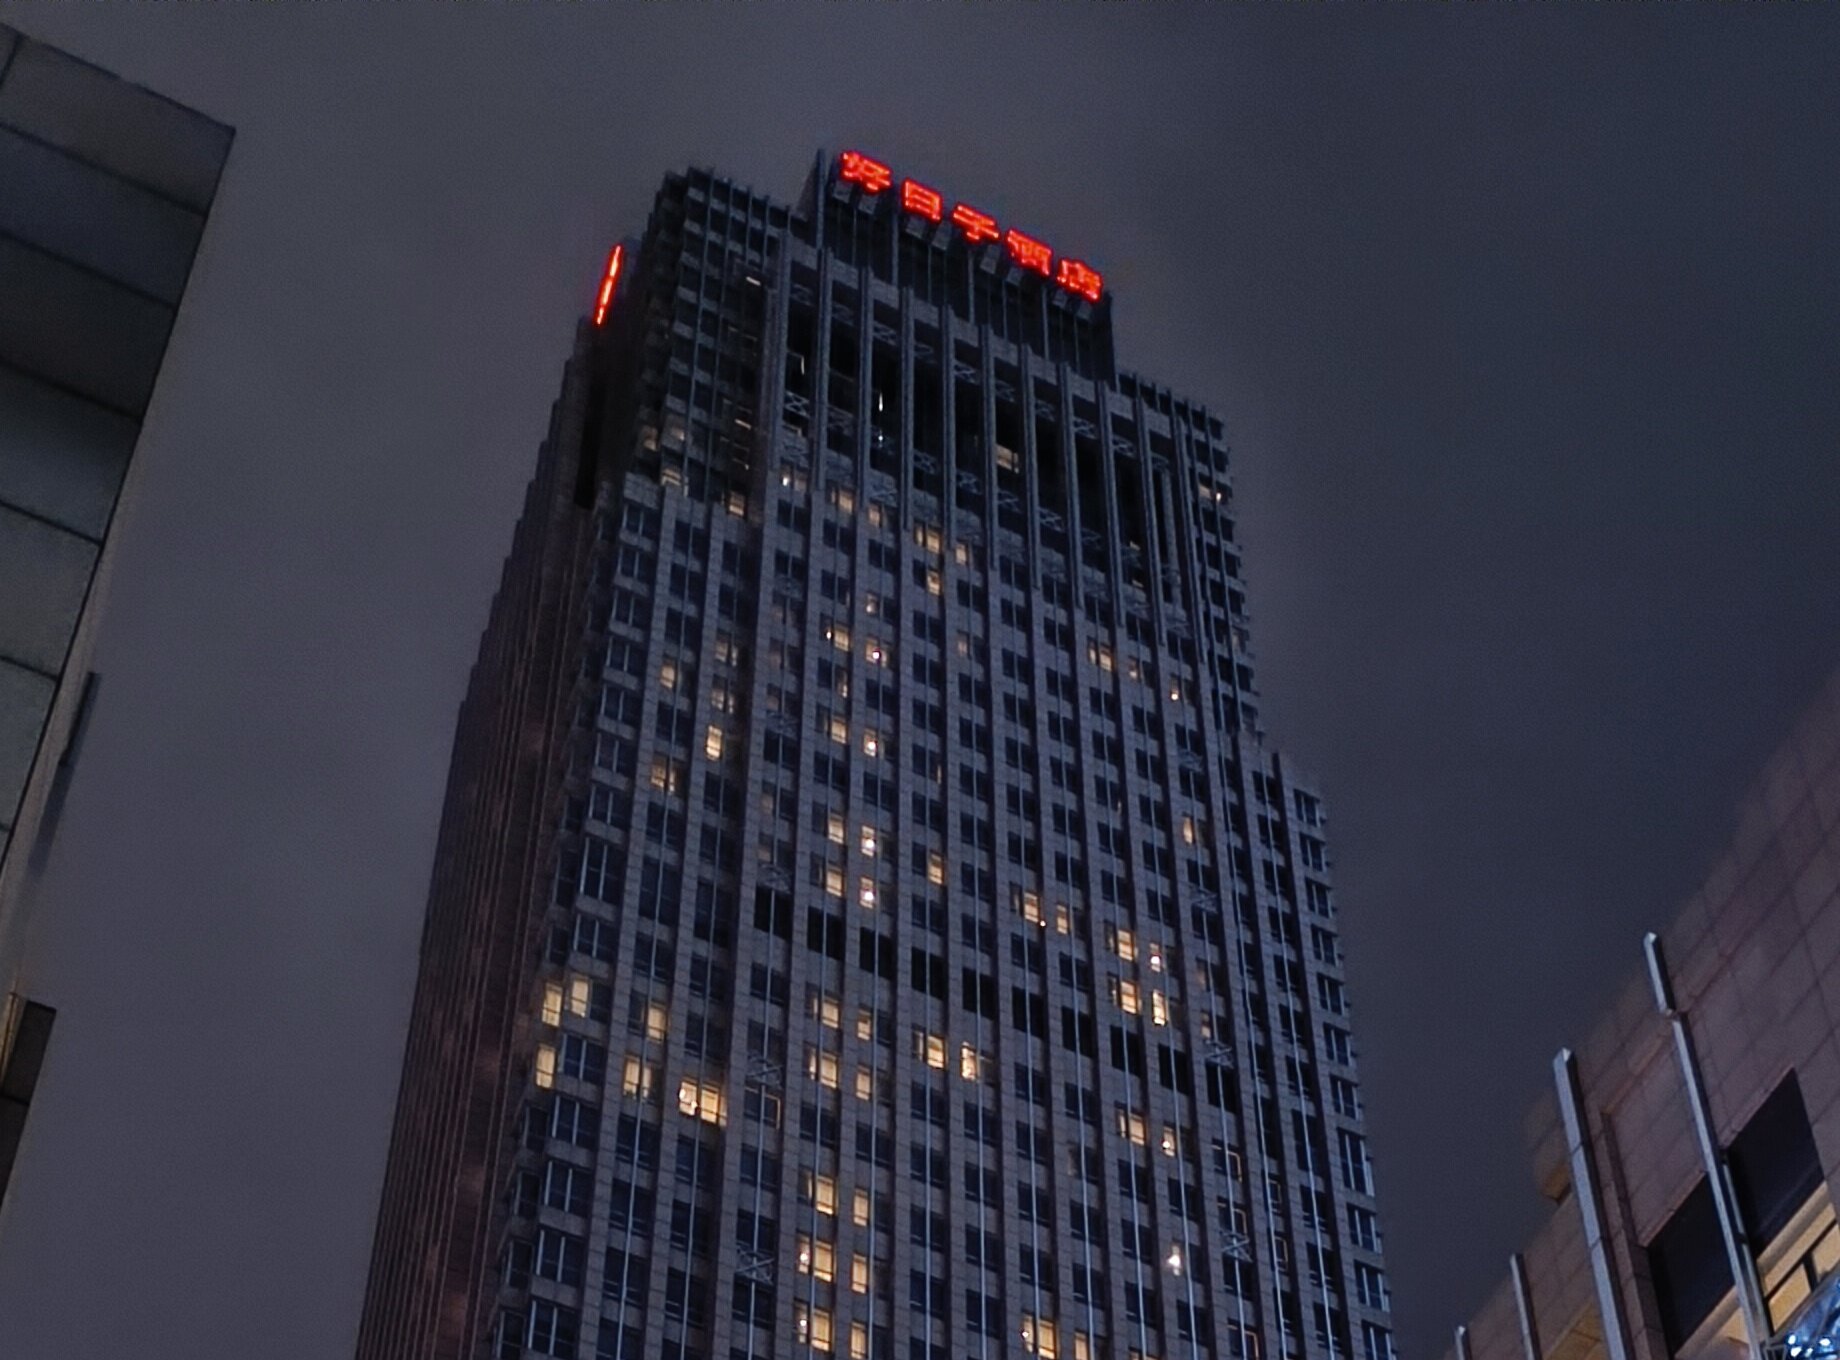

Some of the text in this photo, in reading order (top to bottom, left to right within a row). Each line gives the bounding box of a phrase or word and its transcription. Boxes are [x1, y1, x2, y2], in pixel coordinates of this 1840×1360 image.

[841, 150, 1103, 302] 好日子酒店
